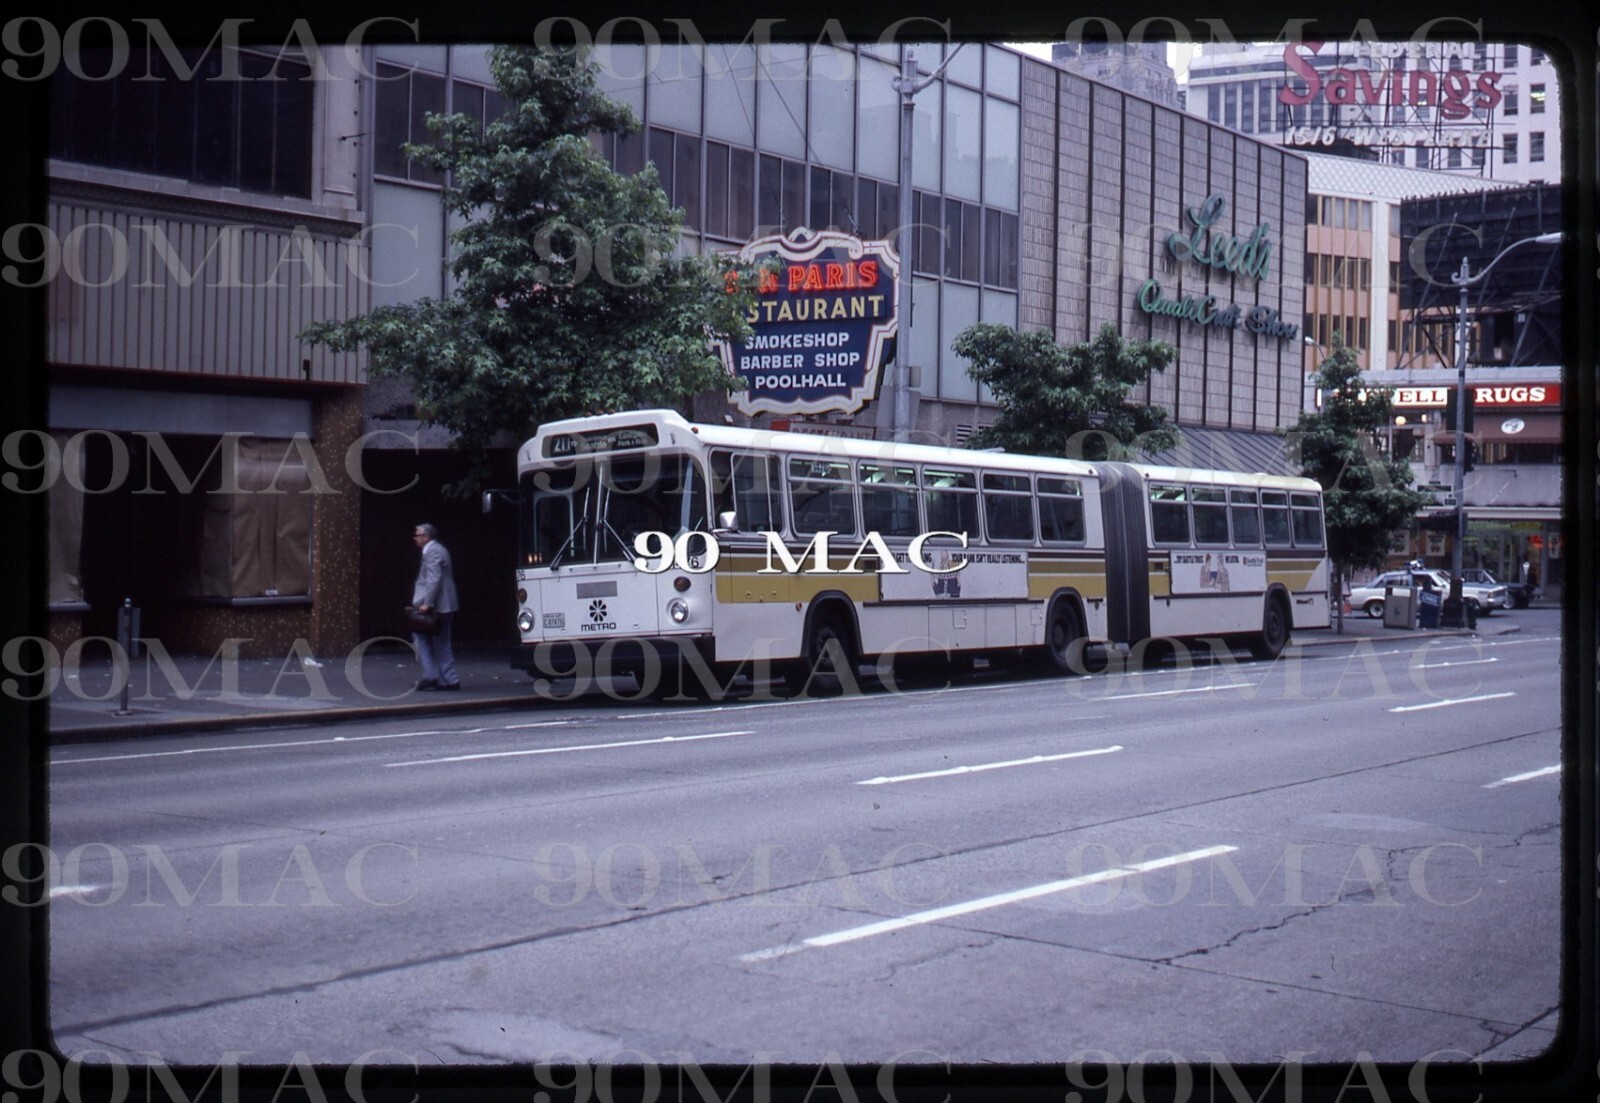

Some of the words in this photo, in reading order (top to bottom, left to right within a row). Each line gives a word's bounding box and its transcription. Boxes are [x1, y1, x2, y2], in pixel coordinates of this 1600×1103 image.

[1279, 41, 1502, 120] Savings
[1285, 126, 1338, 146] 1516
[1354, 126, 1494, 147] WESTLAKE
[788, 260, 879, 292] PARIS
[746, 294, 885, 324] STAURANT
[745, 331, 850, 350] SMOKESHOP
[741, 354, 804, 371] BARBER
[814, 352, 861, 368] SHOP
[755, 373, 847, 390] POOLHALL
[1475, 387, 1545, 403] RUGS
[580, 622, 617, 632] METRO
